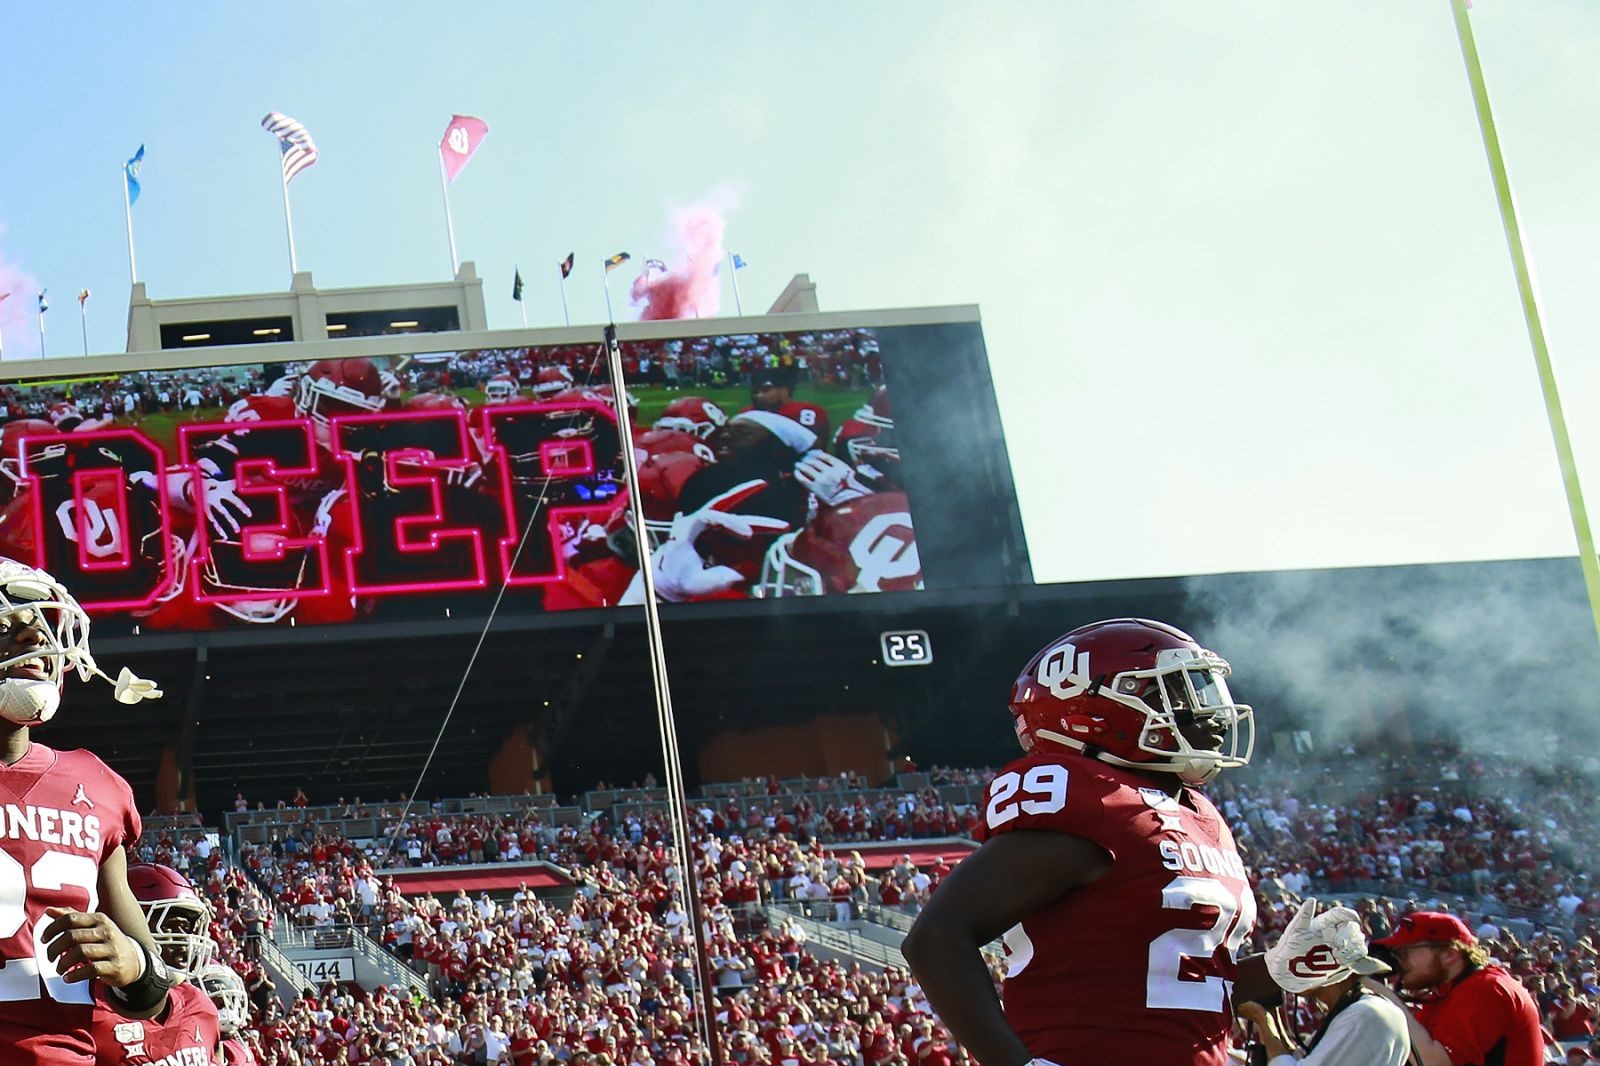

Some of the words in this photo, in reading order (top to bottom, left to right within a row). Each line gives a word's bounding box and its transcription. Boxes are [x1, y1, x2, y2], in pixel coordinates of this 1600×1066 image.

[17, 403, 632, 612] DEEP
[890, 635, 924, 660] 25
[1037, 643, 1091, 700] OU
[986, 764, 1068, 829] 29
[1288, 944, 1339, 978] OU
